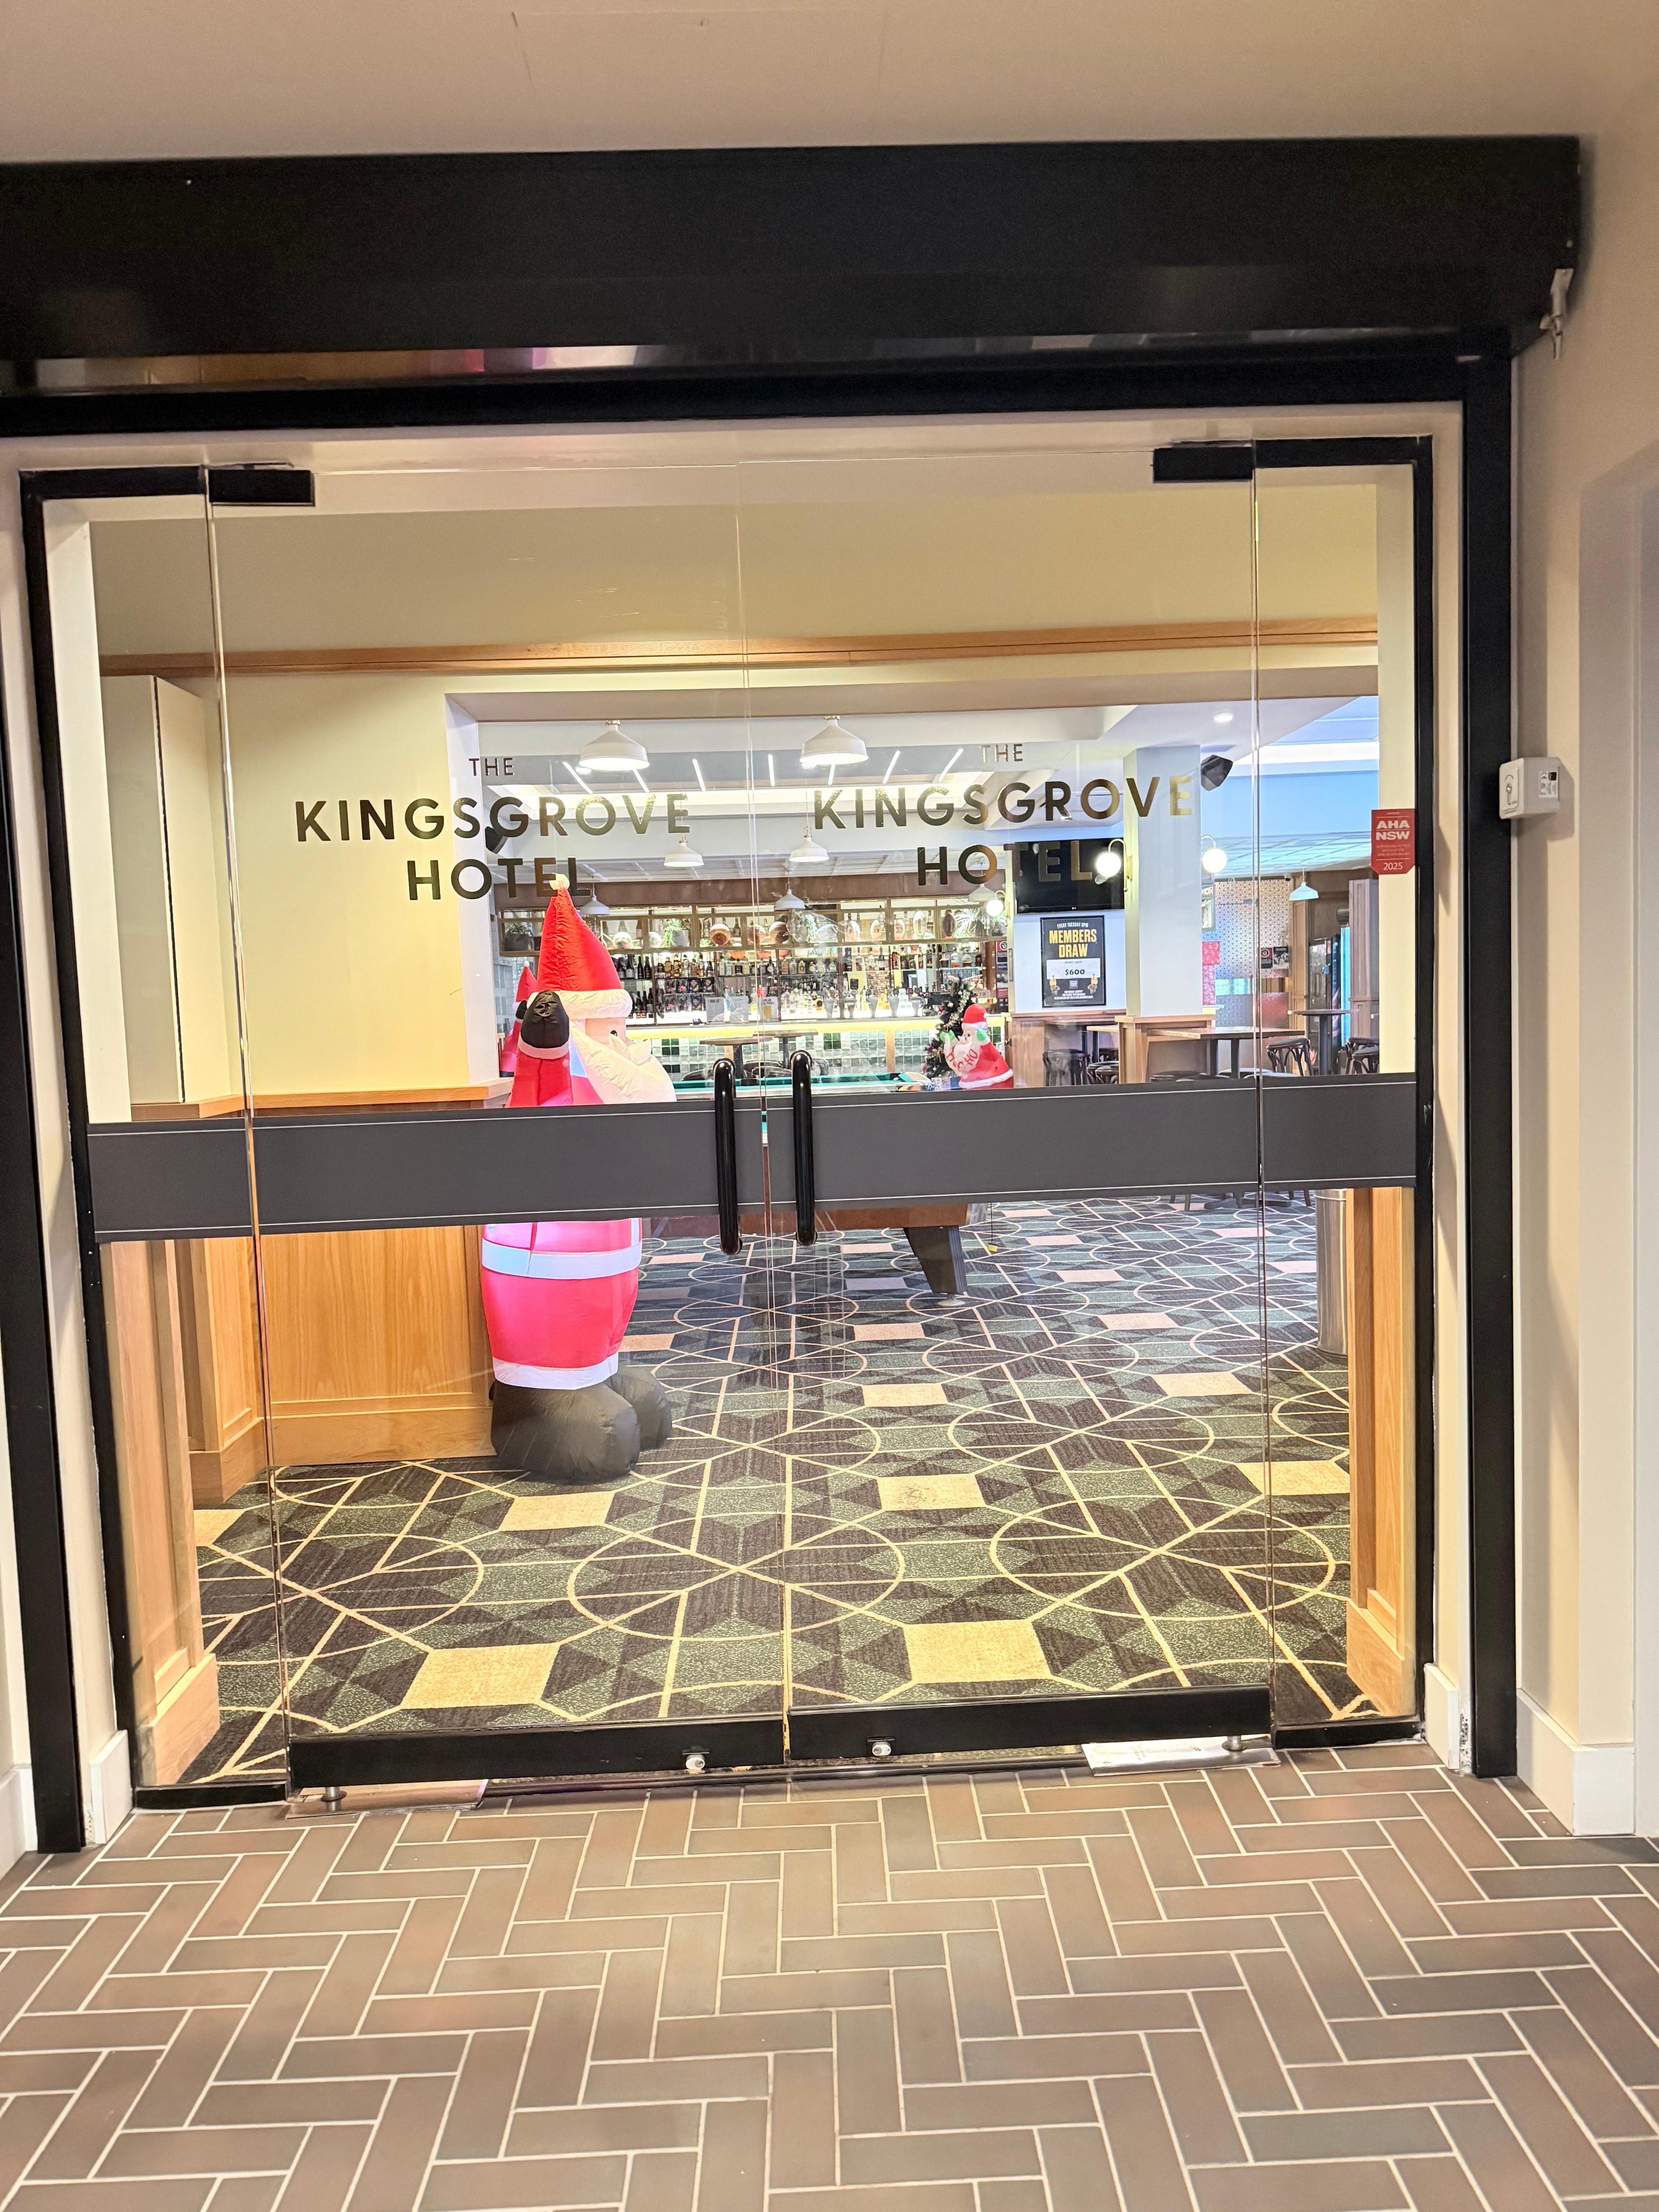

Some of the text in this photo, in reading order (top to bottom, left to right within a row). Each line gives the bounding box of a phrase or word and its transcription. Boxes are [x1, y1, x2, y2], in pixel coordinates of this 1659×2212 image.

[979, 743, 1023, 763] THE
[469, 757, 515, 776] THE
[814, 776, 1193, 830] KINGSGROVE
[295, 793, 690, 842] KINGSGROVE
[1376, 820, 1410, 829] AHA
[1376, 831, 1410, 840] NSW
[917, 840, 1093, 886] HOTEL
[1383, 862, 1403, 871] 2025
[407, 857, 592, 901] HOTEL
[1049, 929, 1097, 944] MEMBERS
[1058, 943, 1088, 958] DRAW
